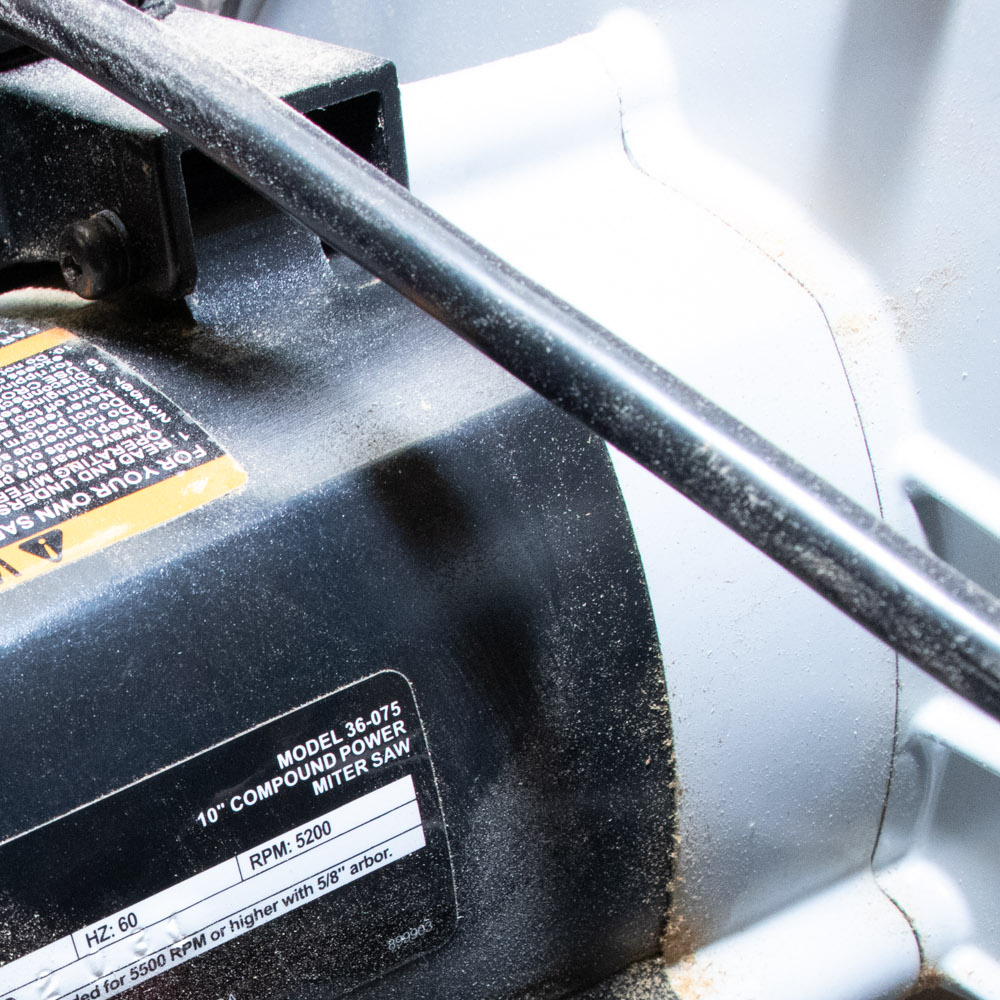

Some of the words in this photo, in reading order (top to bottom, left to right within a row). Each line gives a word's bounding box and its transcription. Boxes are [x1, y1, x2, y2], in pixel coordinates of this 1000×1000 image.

[40, 364, 81, 384] USE
[78, 357, 100, 369] 9.
[87, 362, 108, 374] 8.
[20, 375, 98, 410] changing
[65, 382, 107, 403] Turn
[105, 375, 125, 387] 7.
[114, 381, 135, 393] 6.
[41, 398, 68, 413] off
[63, 389, 117, 415] Never
[96, 396, 126, 412] Do
[123, 389, 143, 401] 5.
[132, 396, 154, 409] 4.
[8, 407, 44, 426] tool
[14, 409, 65, 434] reach
[68, 407, 99, 423] not
[94, 410, 144, 435] Keep
[105, 403, 135, 419] Do
[140, 404, 162, 417] 3.
[150, 412, 171, 425] 2.
[0, 417, 71, 451] perform
[76, 414, 109, 432] not
[89, 419, 154, 450] Always
[9, 424, 79, 458] operate
[43, 429, 98, 457] hands
[169, 430, 190, 443] 1.
[13, 451, 45, 468] out
[46, 443, 93, 467] wear
[52, 428, 165, 479] OPERATING
[115, 437, 173, 466] READ
[155, 443, 209, 471] FOR
[13, 460, 49, 480] eye
[74, 459, 118, 483] AND
[89, 464, 159, 498] YOUR
[33, 490, 94, 522] OWN
[275, 726, 344, 770] MODEL
[343, 699, 403, 738] 36-075
[195, 801, 229, 828] 10"
[228, 750, 339, 813] COMPOUND
[337, 718, 407, 762] POWER
[310, 758, 369, 796] MITER
[369, 737, 414, 768] SAW
[247, 838, 293, 870] RPM:
[293, 819, 334, 849] 5200
[83, 922, 116, 948] HZ:
[115, 911, 139, 933] 60
[102, 970, 130, 993] for
[127, 953, 168, 981] 5500
[167, 932, 208, 961] RPM
[208, 924, 228, 941] or
[226, 896, 282, 935] higher
[279, 880, 315, 908] with
[314, 865, 348, 891] 5/8"
[347, 845, 393, 875] arbor.
